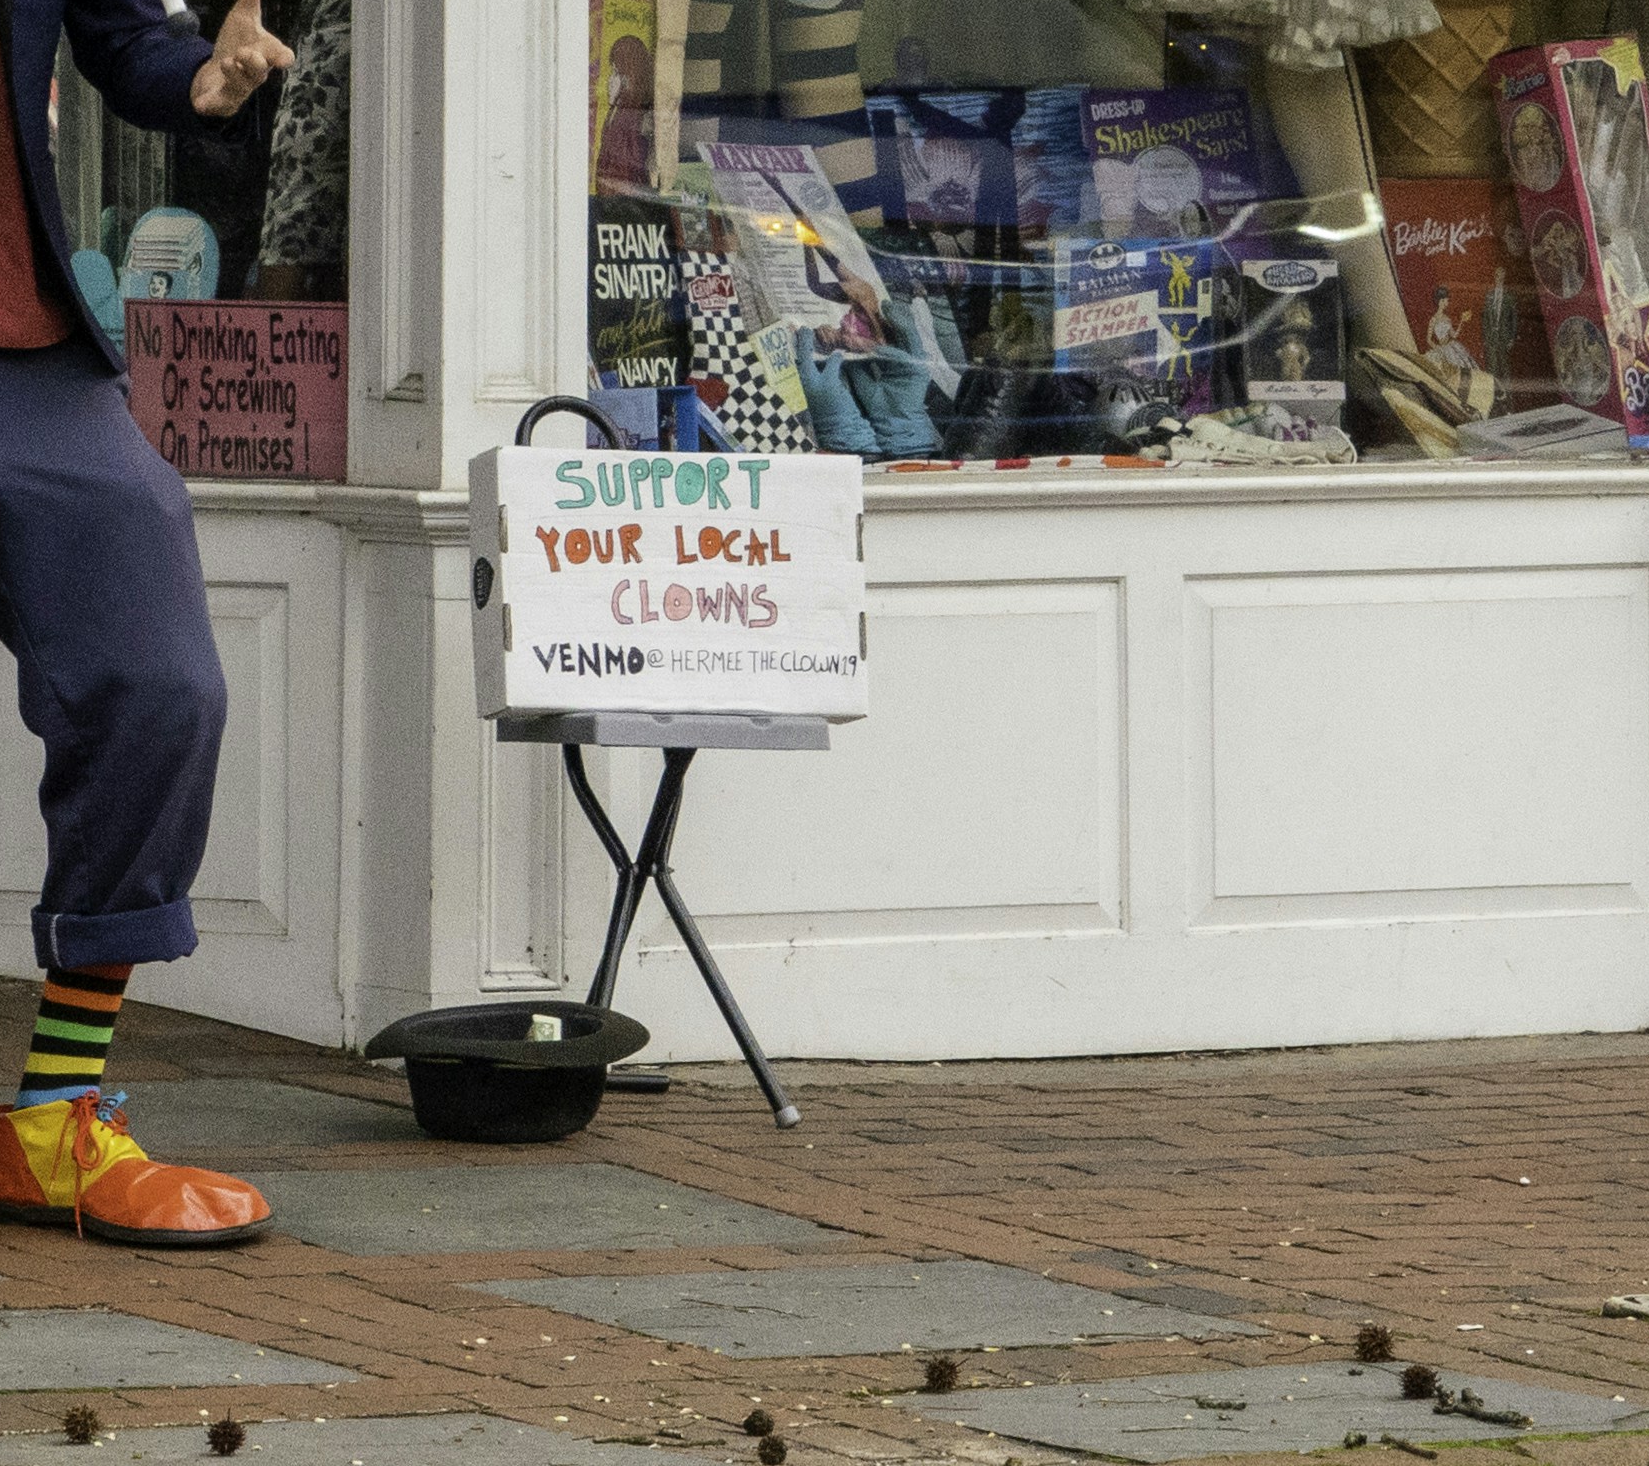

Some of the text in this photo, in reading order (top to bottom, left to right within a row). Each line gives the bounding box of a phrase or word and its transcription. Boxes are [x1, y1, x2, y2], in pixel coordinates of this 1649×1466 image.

[1091, 98, 1147, 122] DRESS-UP
[1094, 108, 1246, 156] Shakespeare
[597, 222, 671, 260] FRANK
[594, 263, 679, 299] SINATRA
[1065, 314, 1149, 346] STAMPER
[1066, 298, 1140, 328] ACTION
[134, 309, 163, 359] No
[268, 312, 342, 380] Eating
[162, 362, 297, 429] Or Screwing
[616, 356, 678, 389] NANCY
[160, 419, 190, 469] On
[554, 457, 771, 511] SUPPORT
[534, 522, 792, 573] YOUR LOCAL
[610, 579, 779, 630] CLOWNS
